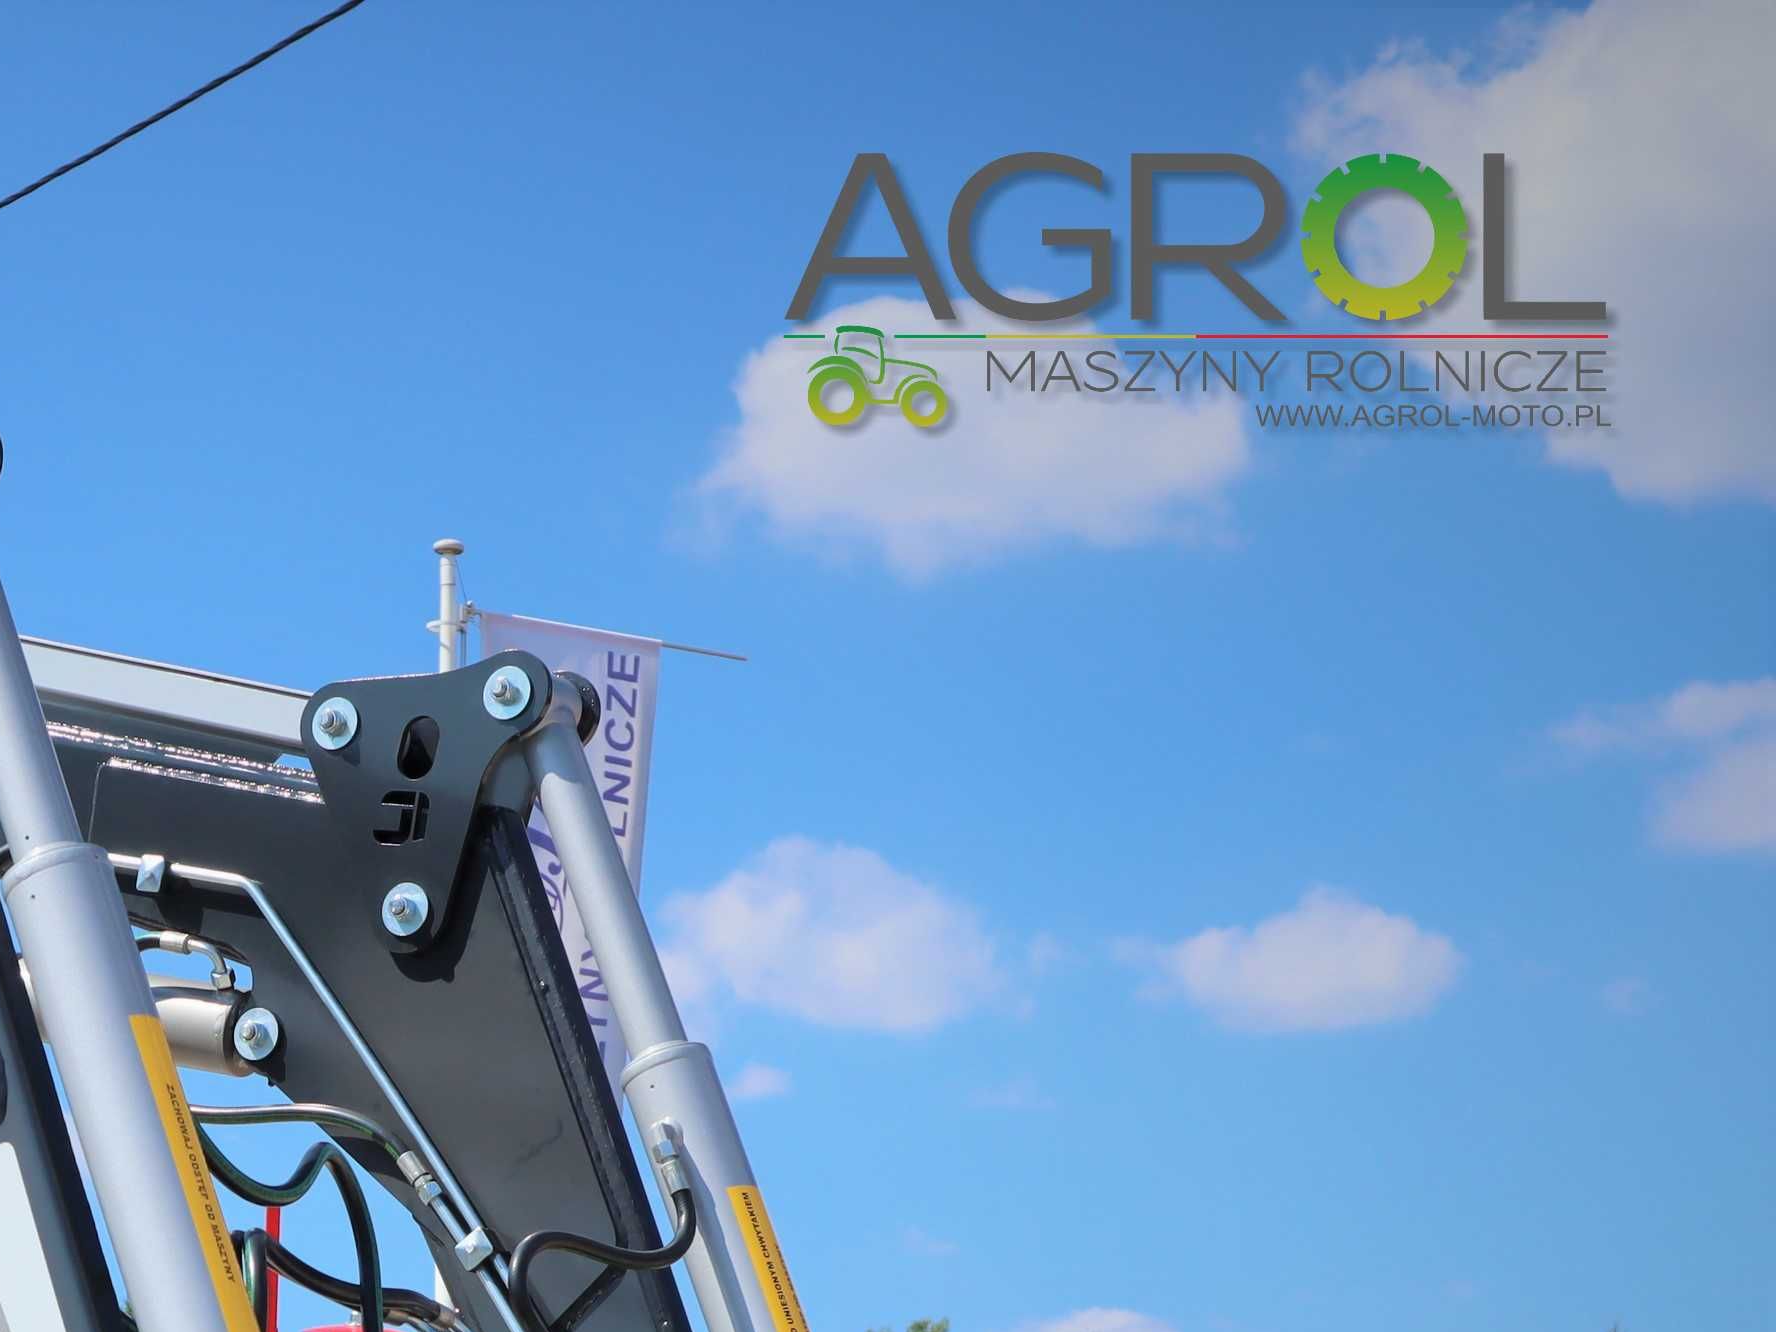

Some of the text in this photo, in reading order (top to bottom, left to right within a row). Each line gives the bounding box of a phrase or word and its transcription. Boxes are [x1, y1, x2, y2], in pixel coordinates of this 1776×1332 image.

[166, 1083, 193, 1151] ZACHOWAJ
[205, 1202, 216, 1221] OD
[211, 1224, 236, 1283] MASZYNY
[741, 1191, 770, 1259] CHWYTAKIEM
[766, 1261, 794, 1325] UNIESIONYM
